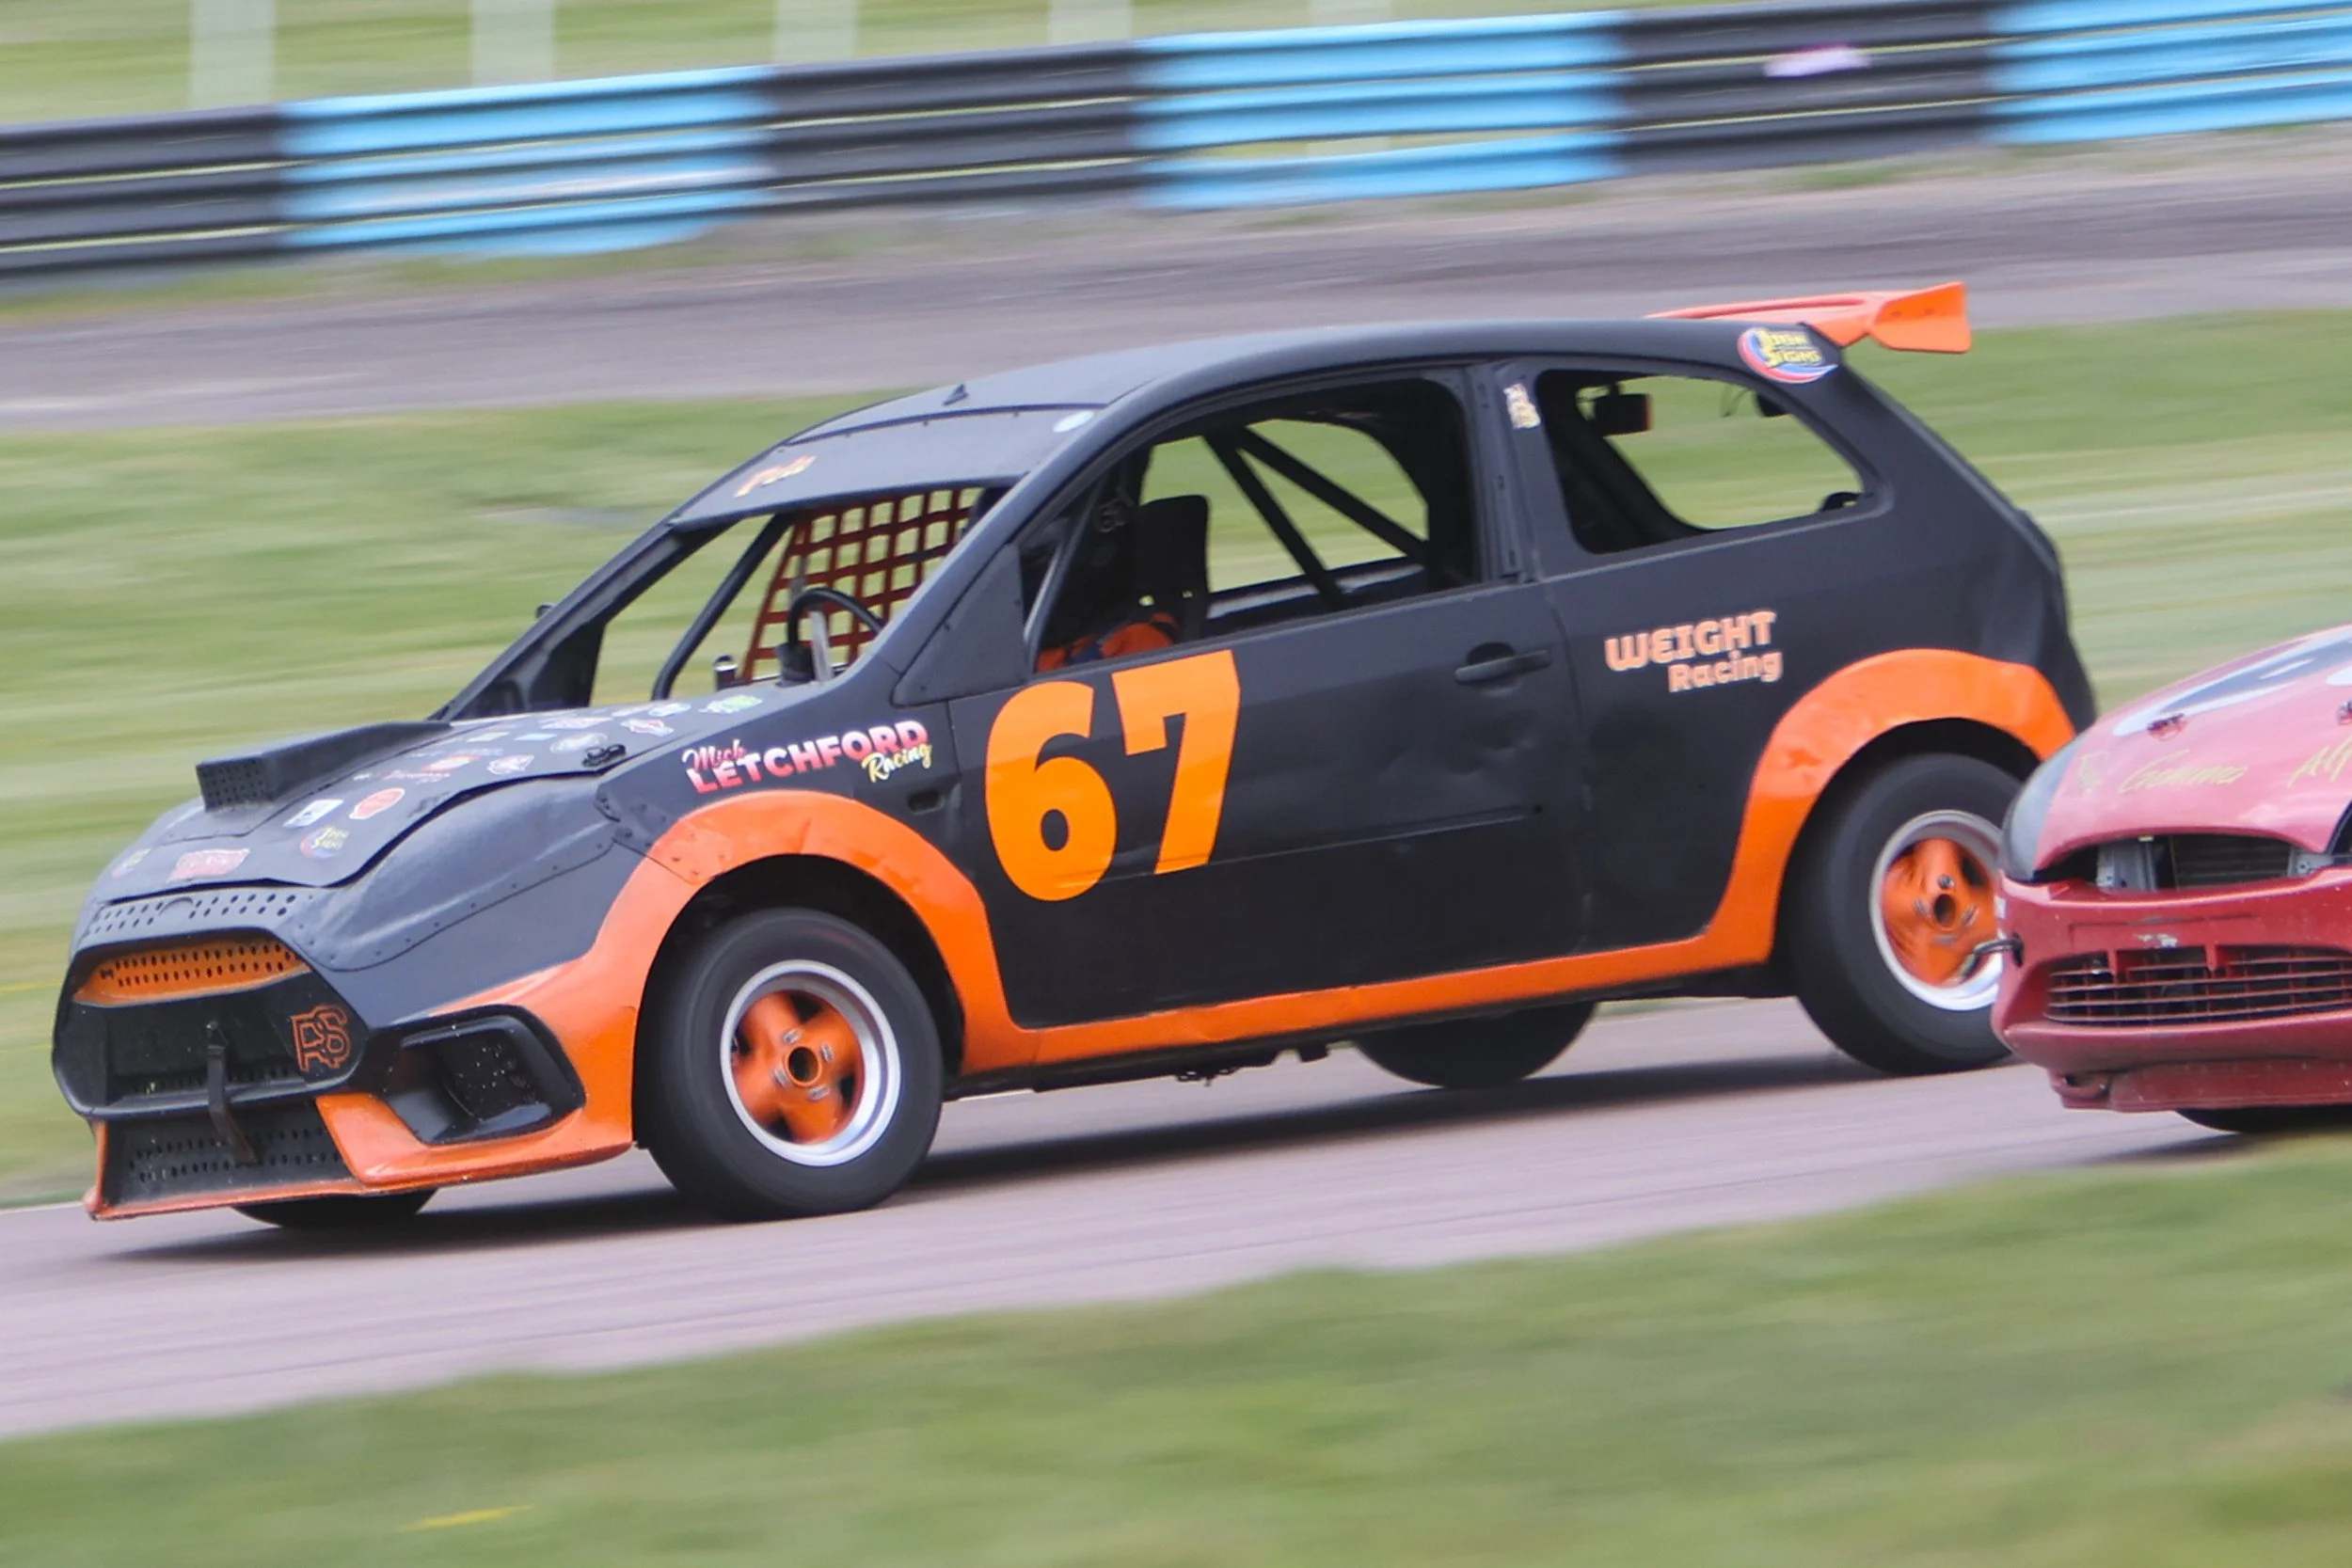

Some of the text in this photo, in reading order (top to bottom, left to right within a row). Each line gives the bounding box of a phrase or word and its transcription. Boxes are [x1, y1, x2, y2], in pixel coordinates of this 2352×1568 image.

[1604, 610, 1777, 672] WEIGHT
[1667, 649, 1784, 693] Racing
[686, 720, 930, 795] LETCHFORD
[860, 743, 933, 784] Racing
[985, 649, 1241, 902] 67
